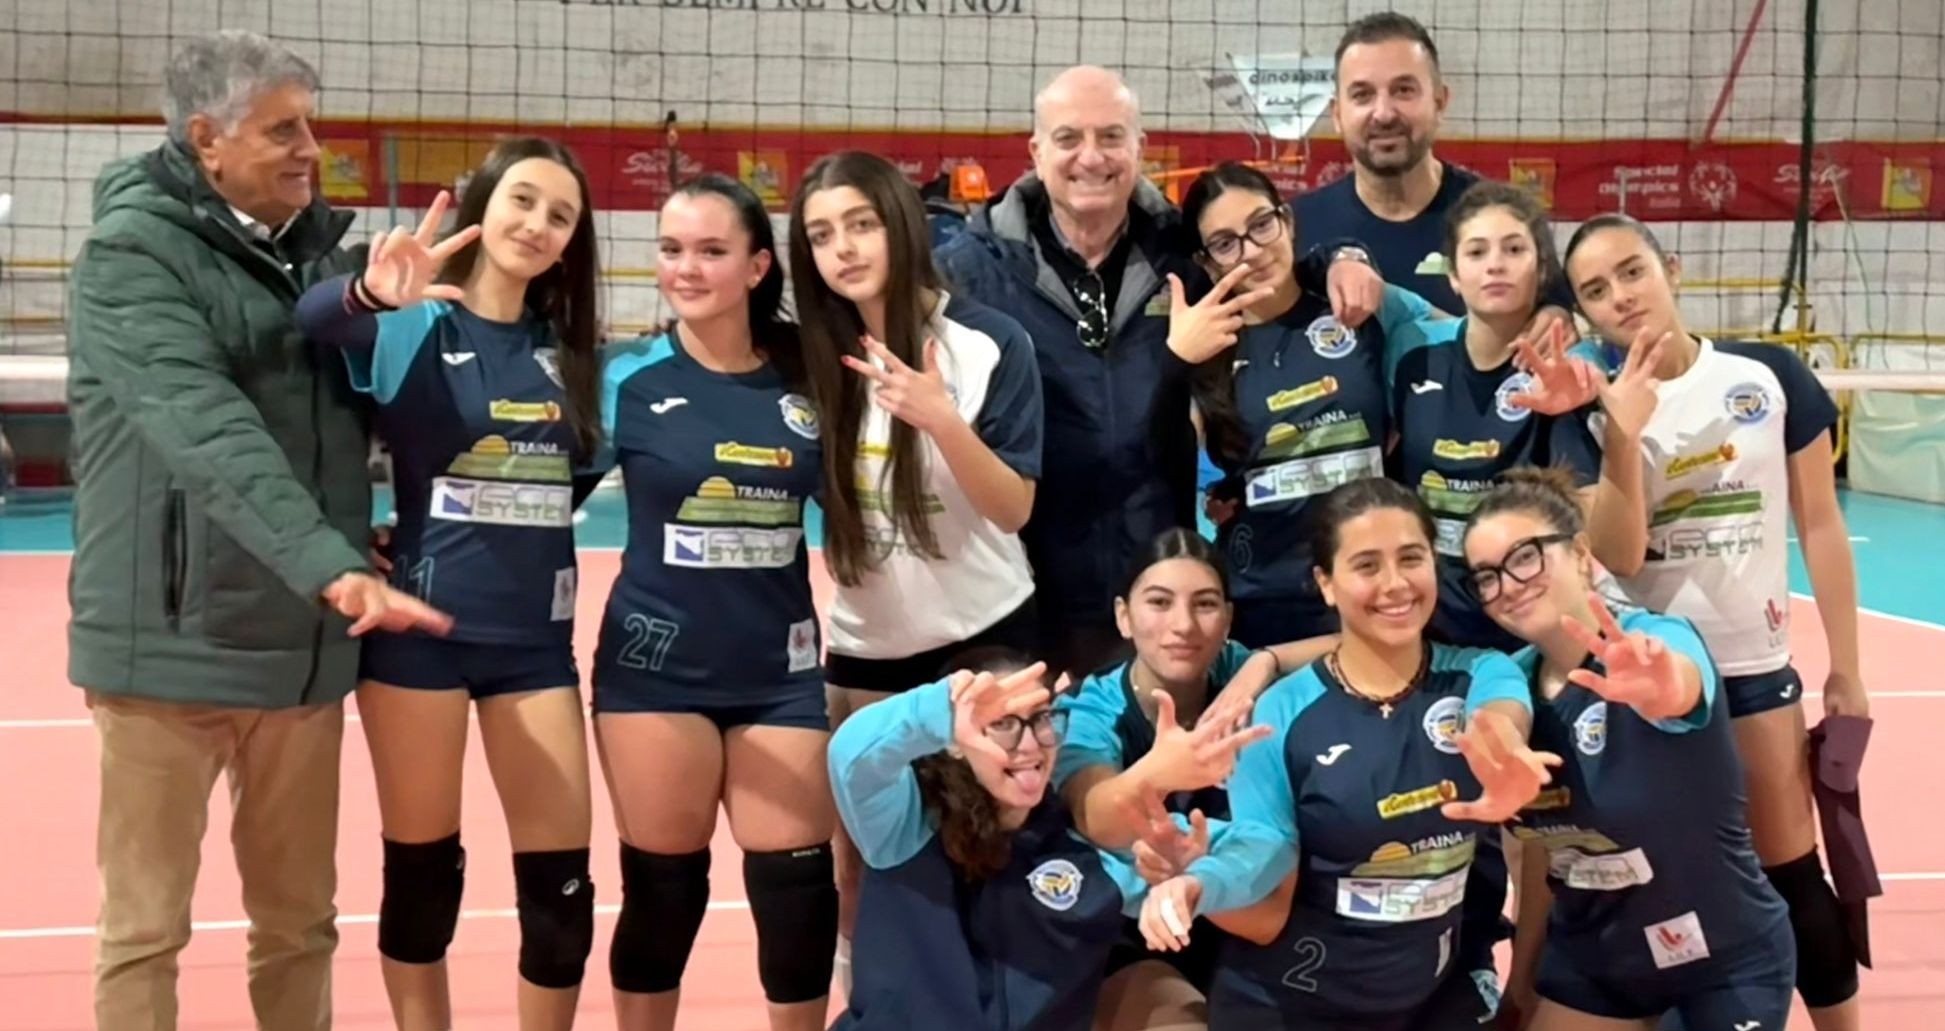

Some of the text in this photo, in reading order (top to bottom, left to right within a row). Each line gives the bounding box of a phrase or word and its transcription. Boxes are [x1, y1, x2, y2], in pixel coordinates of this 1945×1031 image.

[736, 486, 788, 500] TRAINA
[617, 612, 679, 671] 27
[1282, 936, 1327, 993] 2
